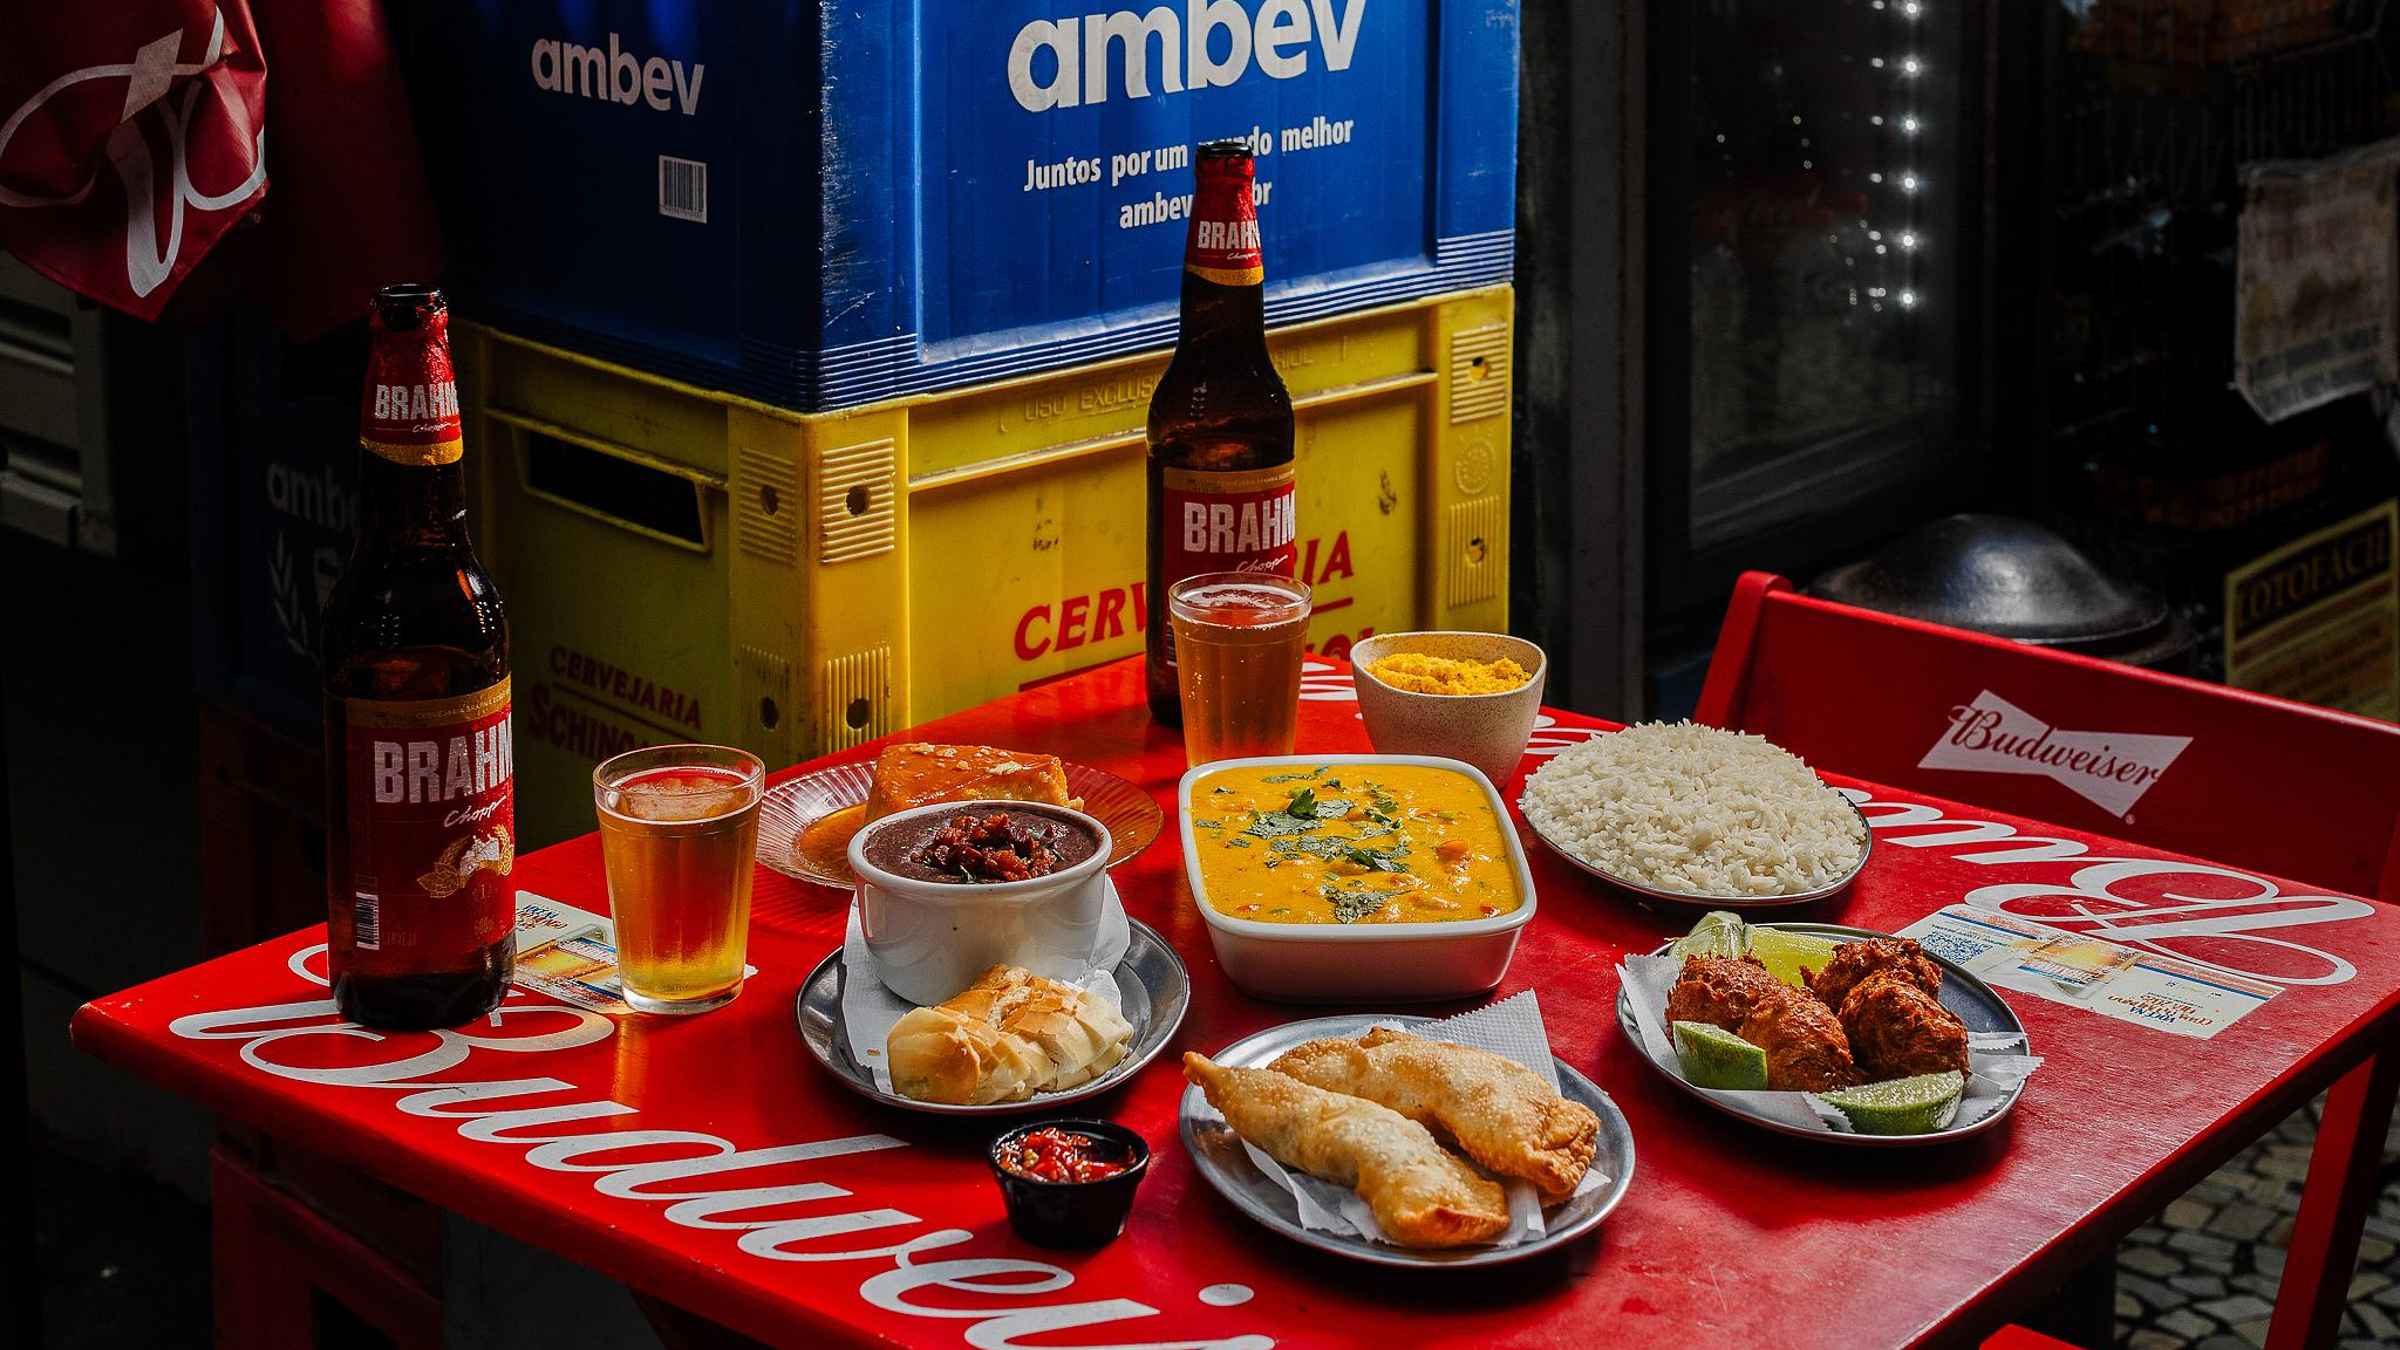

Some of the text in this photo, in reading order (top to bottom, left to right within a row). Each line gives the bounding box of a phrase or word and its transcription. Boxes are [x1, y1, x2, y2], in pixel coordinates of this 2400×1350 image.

[531, 31, 705, 116] ambev
[1008, 0, 1366, 112] ambev
[1023, 156, 1101, 192] Juntos
[1112, 149, 1151, 187] por
[1154, 142, 1188, 171] um
[1281, 115, 1354, 153] melhor
[551, 647, 702, 731] CERVEJARIA
[1948, 705, 2159, 786] Budweiser
[168, 942, 1277, 1350] Budwei
